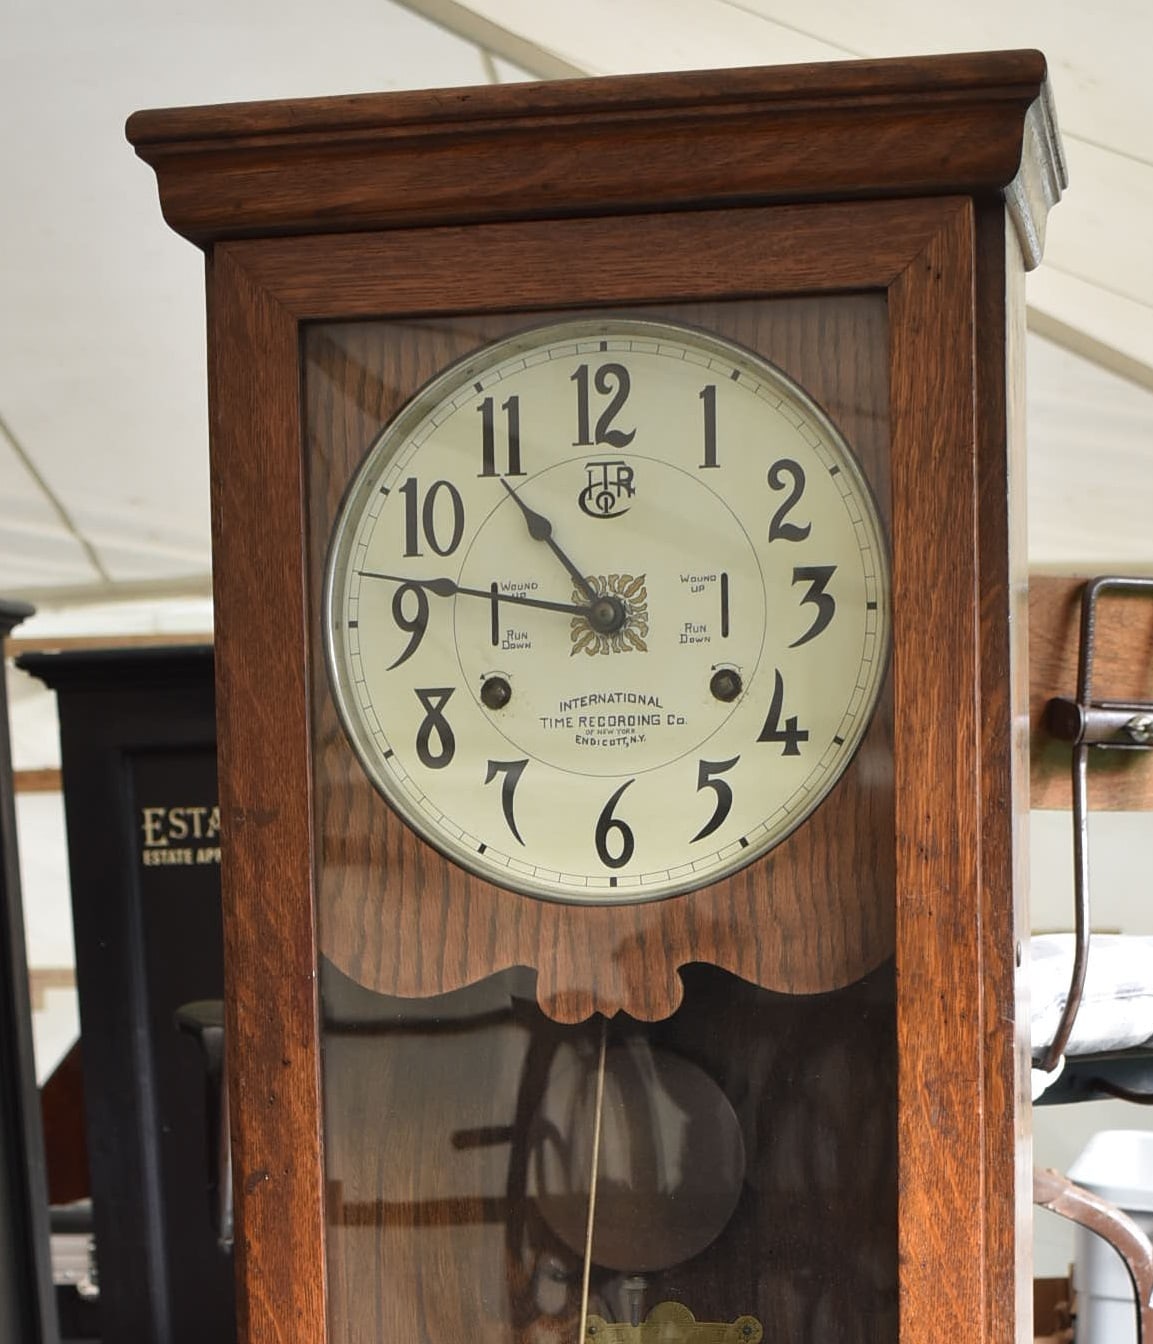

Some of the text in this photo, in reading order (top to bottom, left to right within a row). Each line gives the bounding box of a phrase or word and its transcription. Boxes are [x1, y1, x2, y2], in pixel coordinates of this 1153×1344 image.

[476, 395, 527, 478] 11
[570, 363, 636, 447] 12
[698, 384, 721, 468] 1
[398, 477, 465, 558] 10
[767, 459, 812, 542] 2
[385, 582, 430, 671] 9
[788, 565, 838, 648] 3
[414, 687, 456, 769] 8
[540, 717, 573, 729] TIME
[579, 714, 661, 728] RECORDING
[559, 692, 663, 712] INTERNATIONAL
[757, 668, 809, 756] 4
[485, 758, 529, 846] 7
[595, 778, 636, 868] 6
[690, 755, 741, 843] 5
[143, 848, 193, 865] ESTATE
